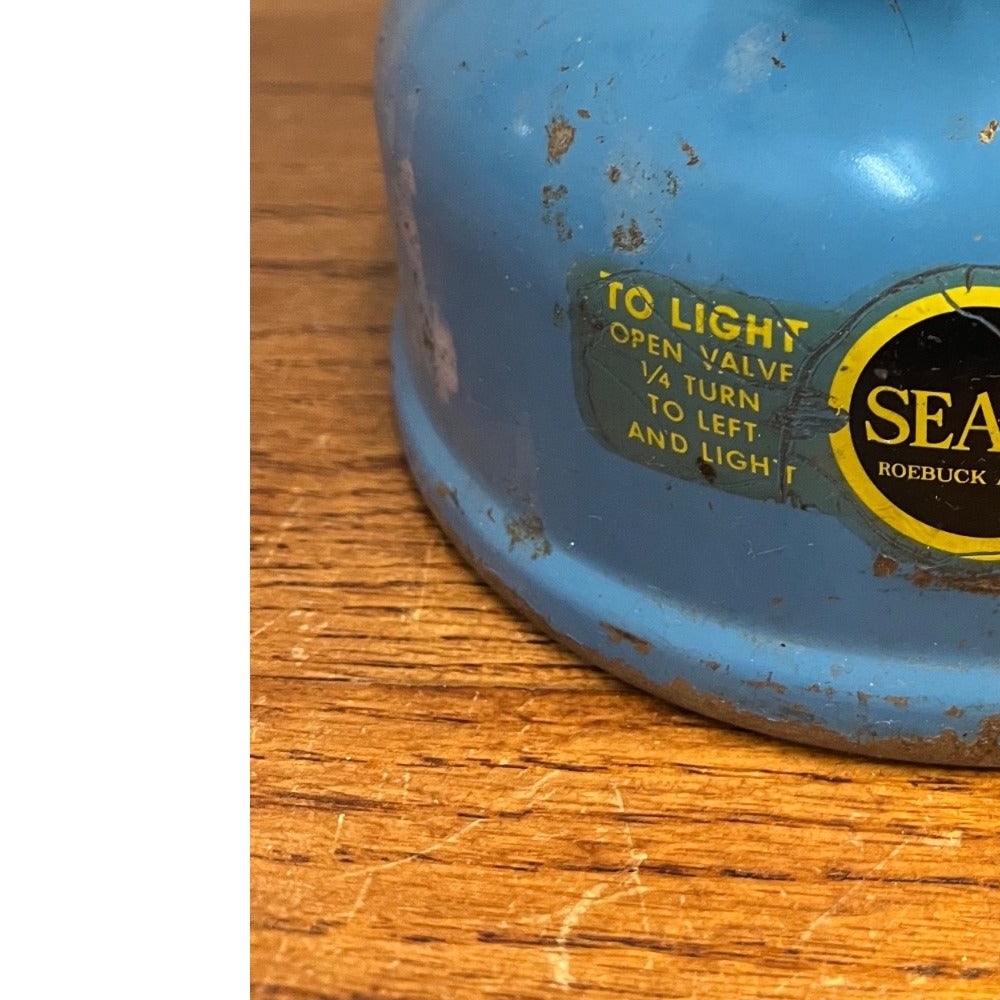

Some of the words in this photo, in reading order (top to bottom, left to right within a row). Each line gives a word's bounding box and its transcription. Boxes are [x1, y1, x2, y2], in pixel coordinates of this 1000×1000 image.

[600, 270, 654, 320] TO
[671, 297, 809, 353] LIGHT
[610, 321, 682, 363] OPEN
[700, 344, 794, 383] VALVE
[648, 393, 684, 422] TO
[698, 410, 757, 442] LEFT
[684, 374, 760, 412] TURN
[628, 421, 688, 454] AND
[702, 441, 797, 484] LIGHT
[878, 461, 987, 485] ROEBUCK
